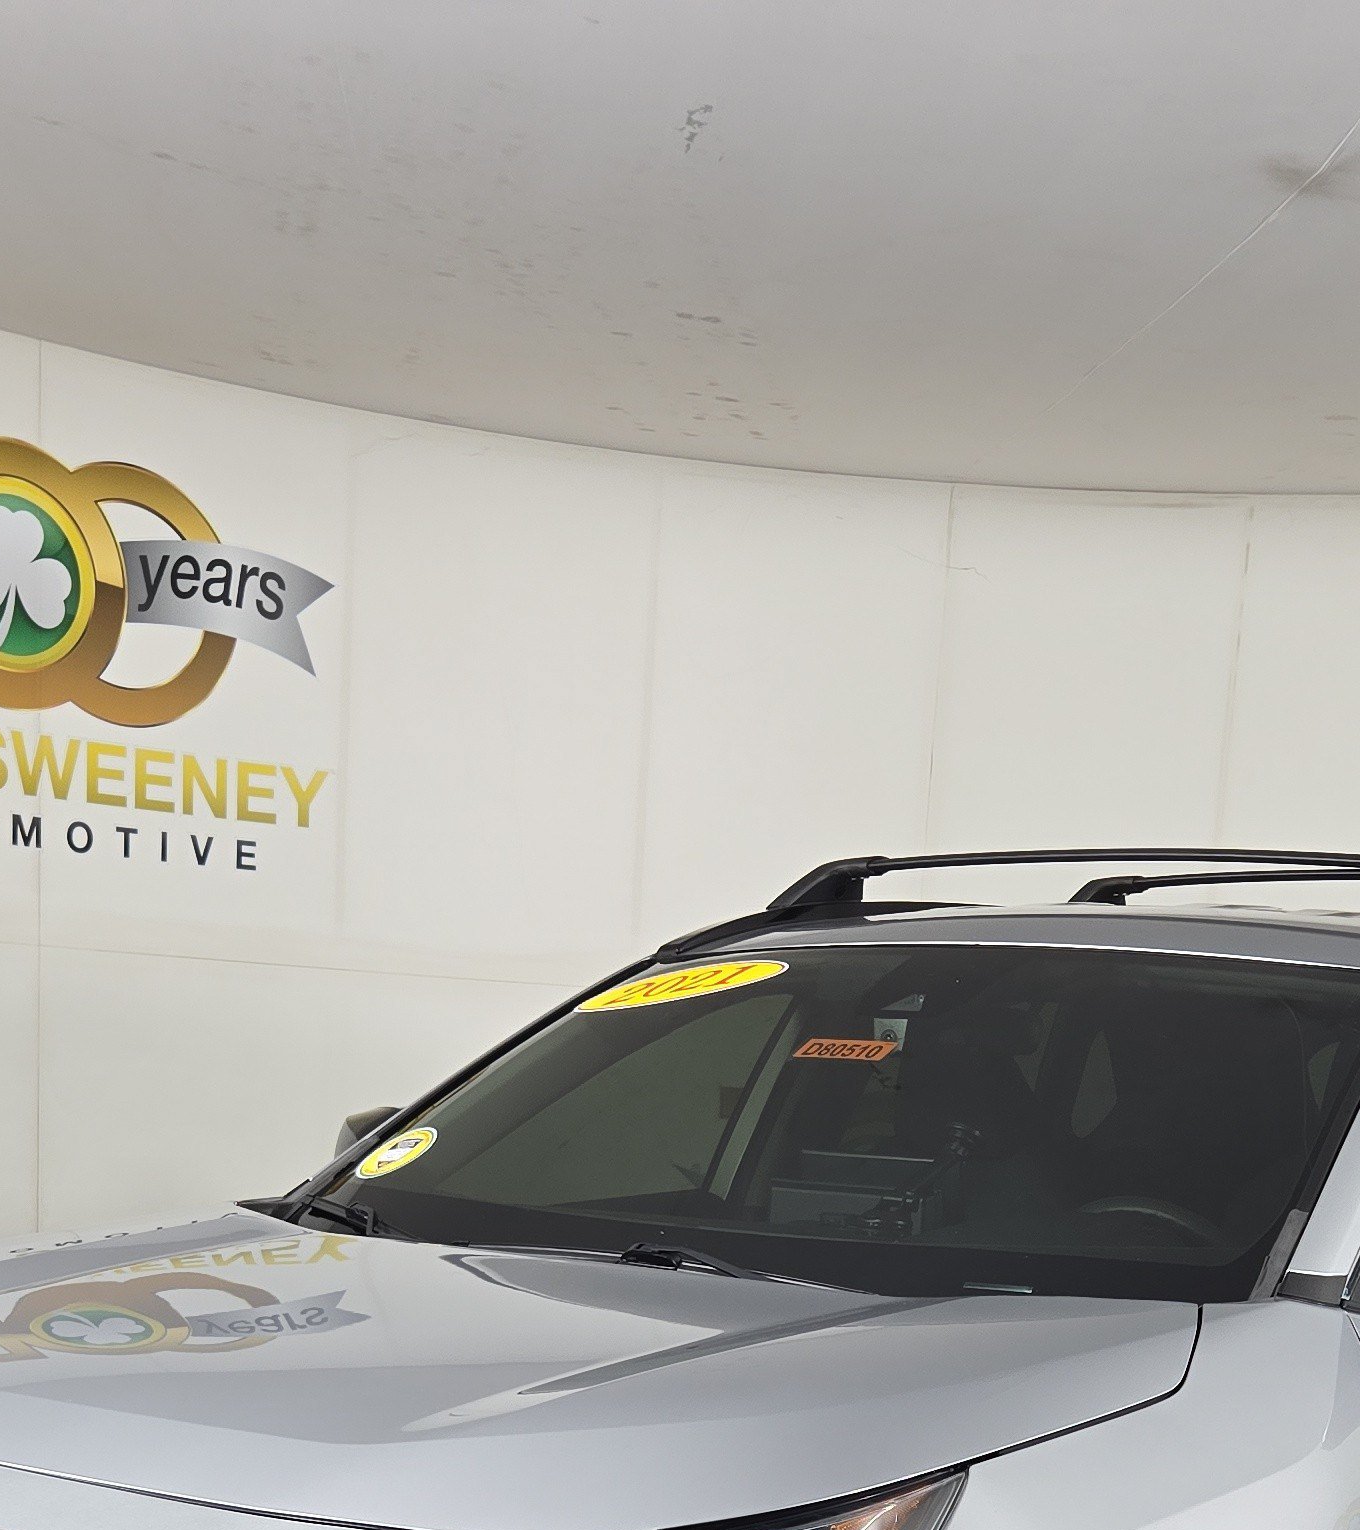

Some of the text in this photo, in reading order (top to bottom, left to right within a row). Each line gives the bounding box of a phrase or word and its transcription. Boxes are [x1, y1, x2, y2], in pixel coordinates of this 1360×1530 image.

[138, 553, 285, 621] years
[602, 964, 758, 1006] 2021
[801, 1042, 884, 1059] D80510
